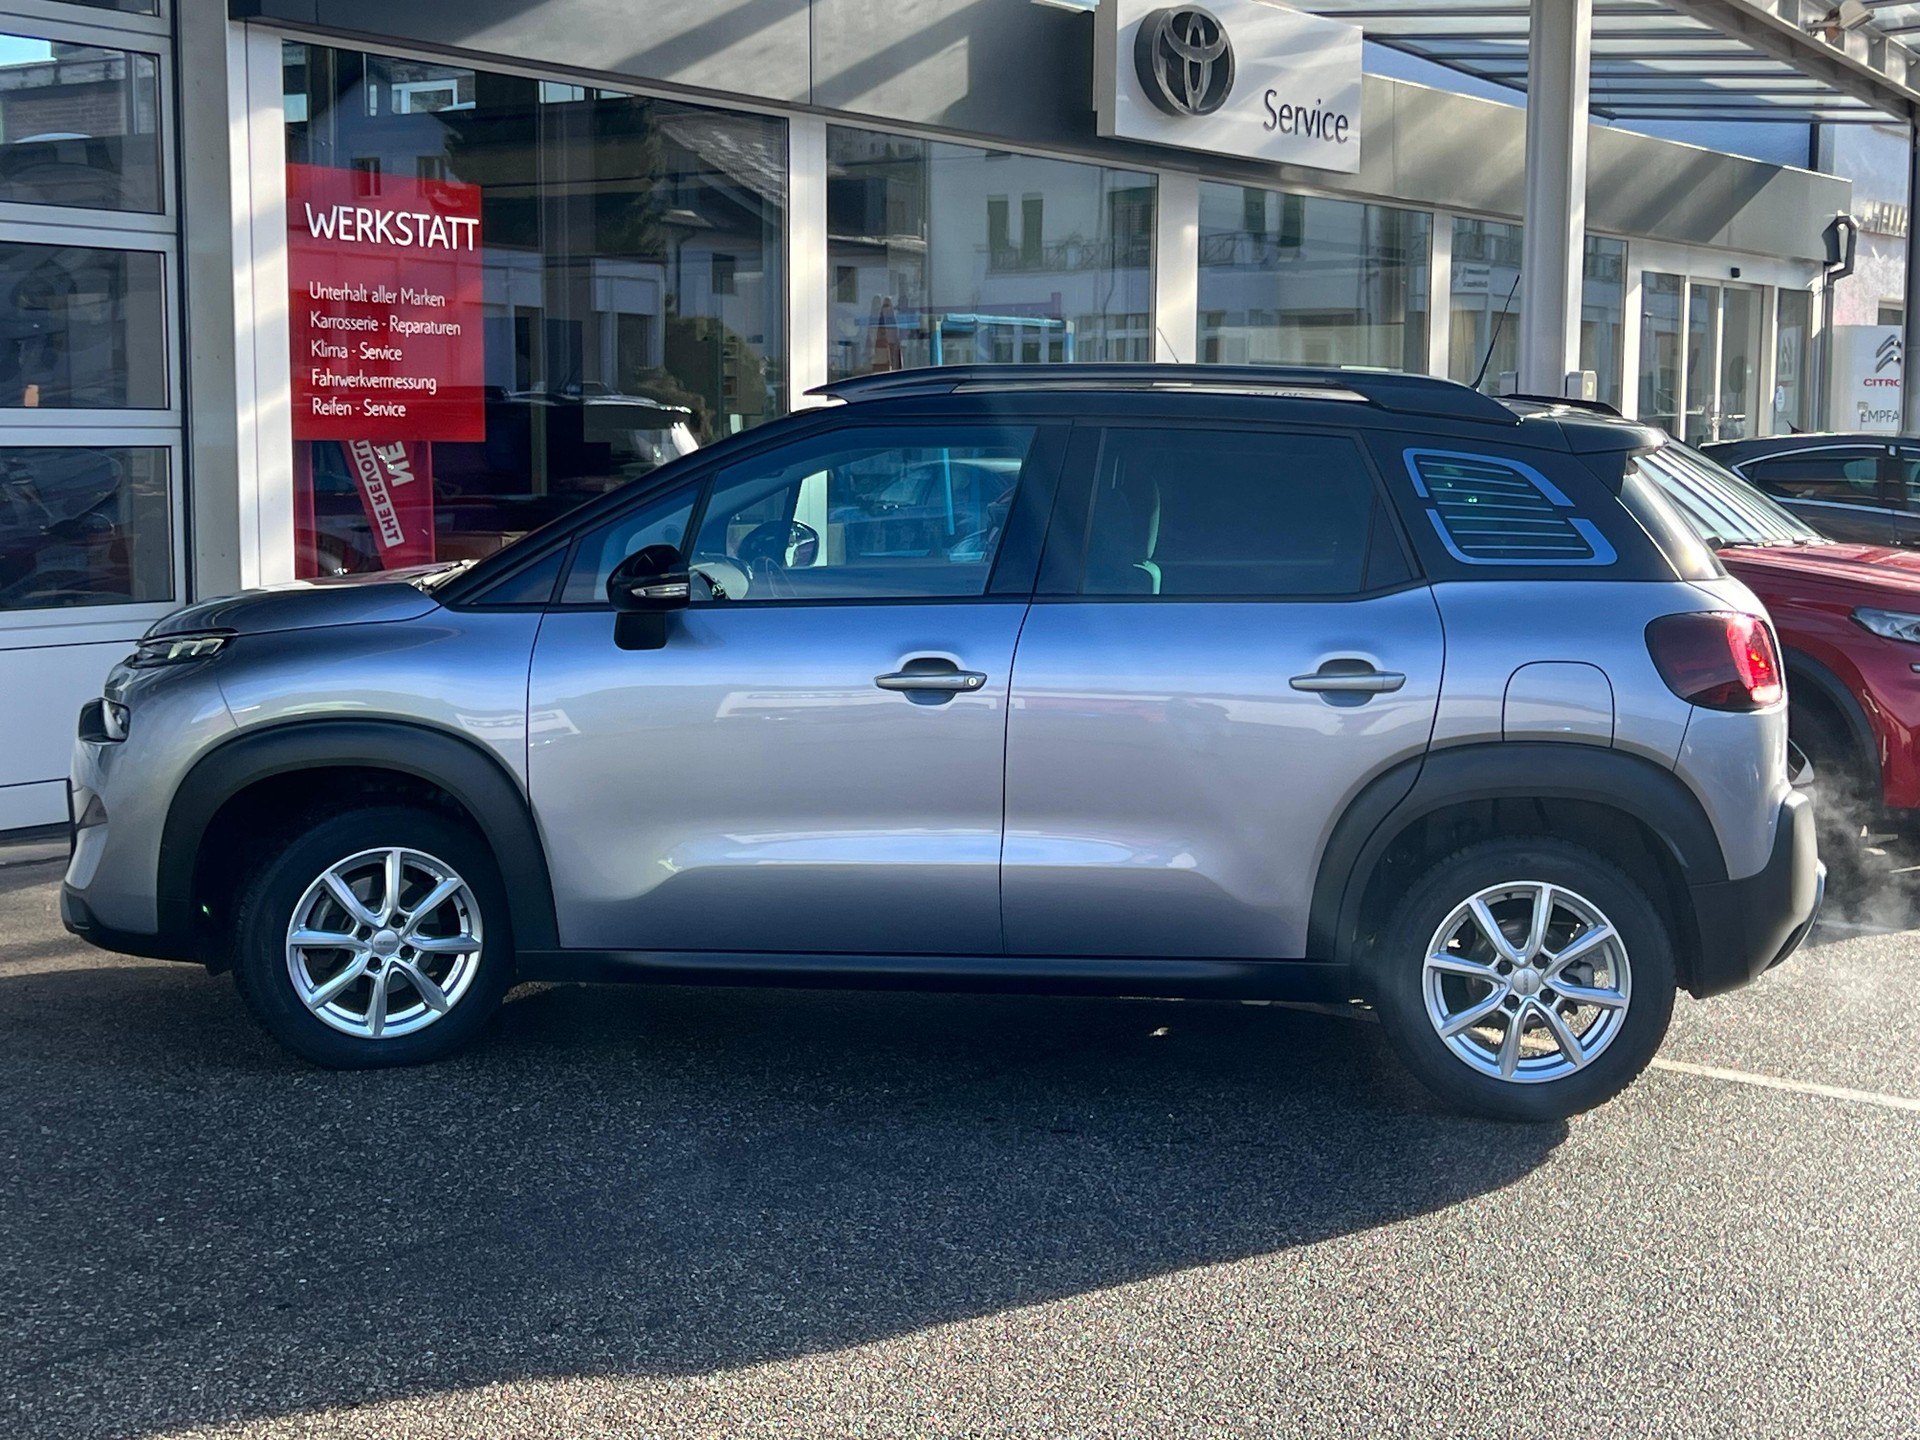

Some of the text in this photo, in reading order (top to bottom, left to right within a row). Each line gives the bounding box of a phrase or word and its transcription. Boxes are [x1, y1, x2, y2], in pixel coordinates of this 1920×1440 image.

[1263, 89, 1349, 144] Service
[304, 202, 479, 251] WERKSTATT
[309, 281, 446, 307] Unterhalt aller Marken
[310, 310, 379, 332] Karrosserie
[389, 314, 461, 338] Reparaturen
[311, 339, 348, 359] Klima
[359, 341, 403, 361] Service
[311, 368, 437, 395] Fahrwerkvermessung
[312, 396, 352, 416] Reifen
[363, 398, 407, 417] Service
